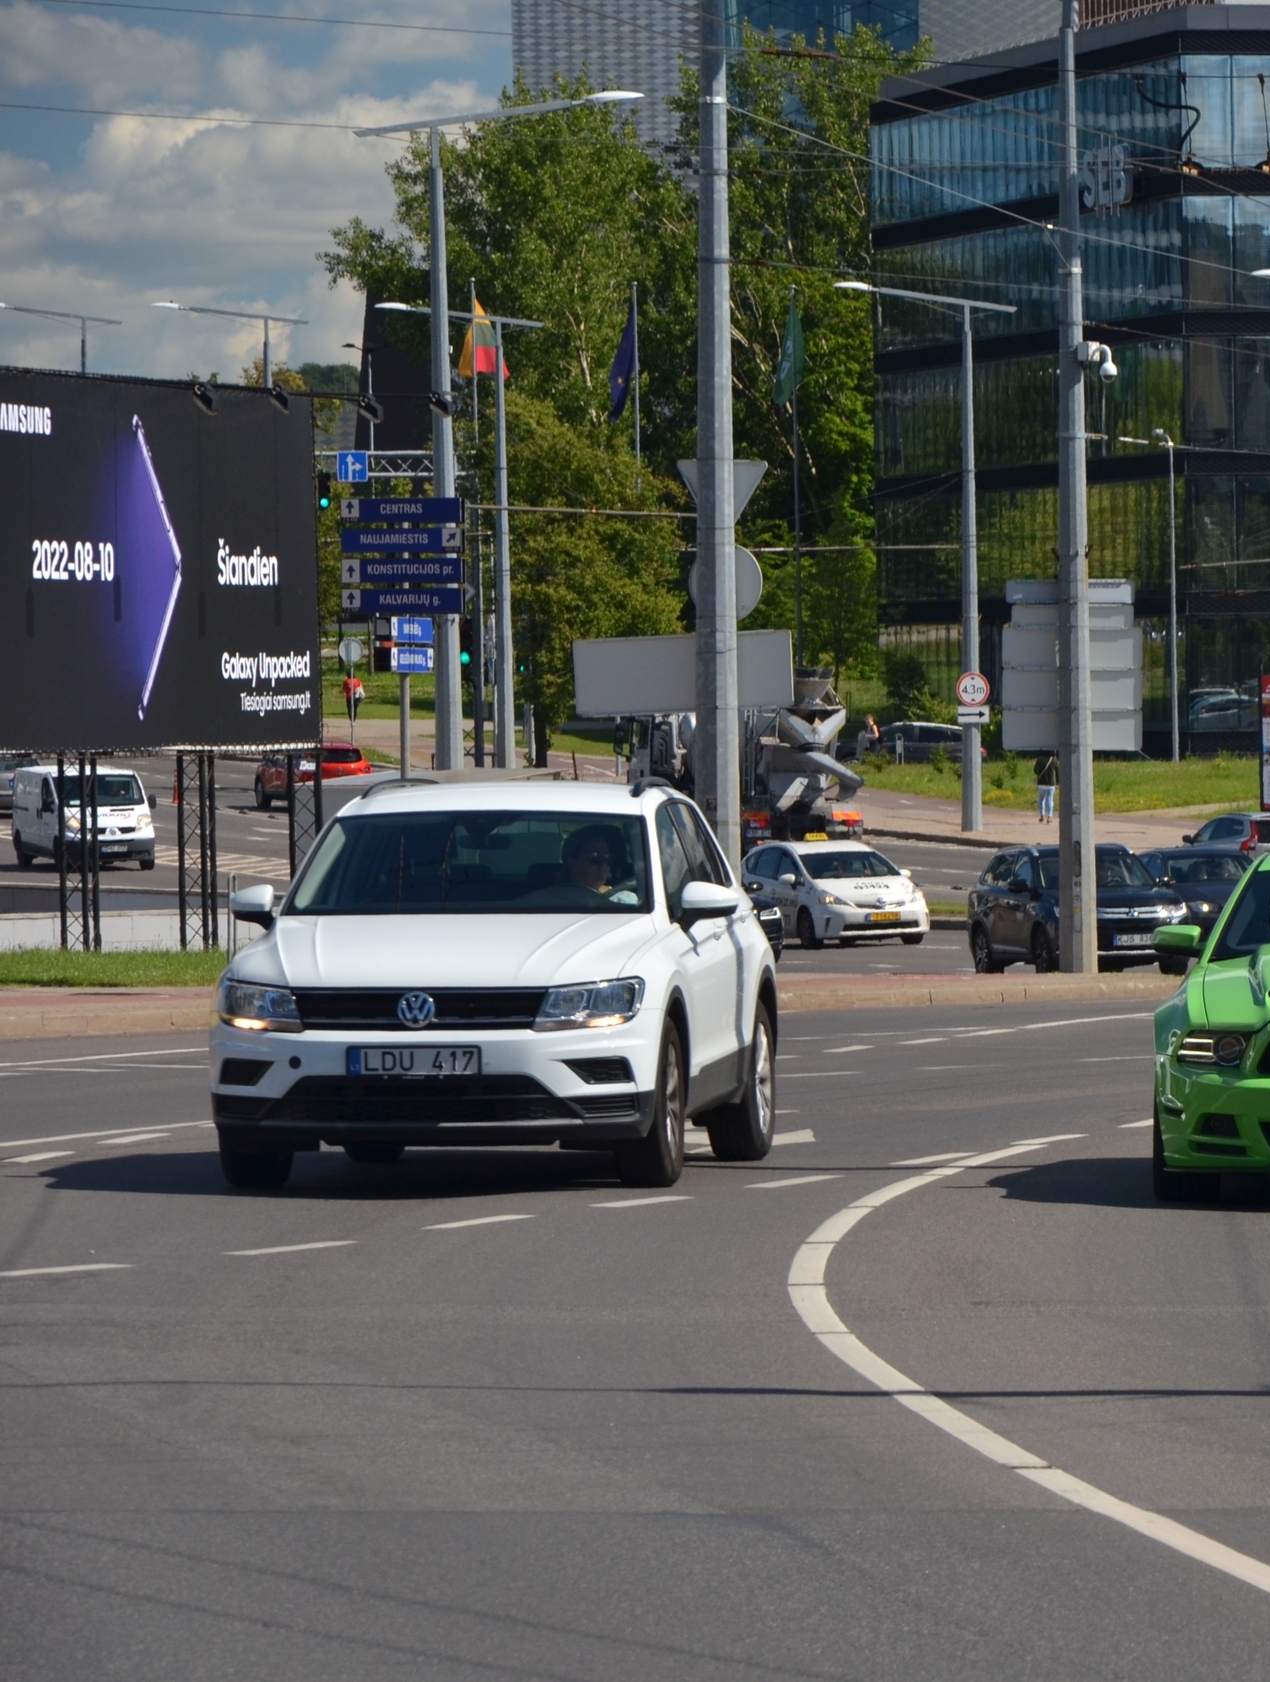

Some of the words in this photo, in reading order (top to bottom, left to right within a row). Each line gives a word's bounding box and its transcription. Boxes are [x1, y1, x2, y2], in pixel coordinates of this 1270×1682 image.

[0, 402, 51, 435] AMSUNG
[380, 503, 423, 515] CENTRAS
[360, 533, 429, 545] NAUJAMIESTIS
[32, 539, 114, 581] 2022-08-10
[217, 538, 278, 586] Šiandien
[367, 563, 440, 575] KONSTITUCIJOS
[442, 565, 455, 576] pr.
[379, 594, 430, 607] KALVARIJŲ
[432, 595, 441, 606] g.
[221, 651, 258, 688] Galaxy
[259, 650, 311, 688] Unpacked
[240, 691, 273, 717] Tiesiogiai
[273, 690, 311, 715] samsung.lt
[1117, 935, 1135, 944] KJS
[364, 1050, 414, 1072] LDU
[432, 1050, 475, 1071] 417
